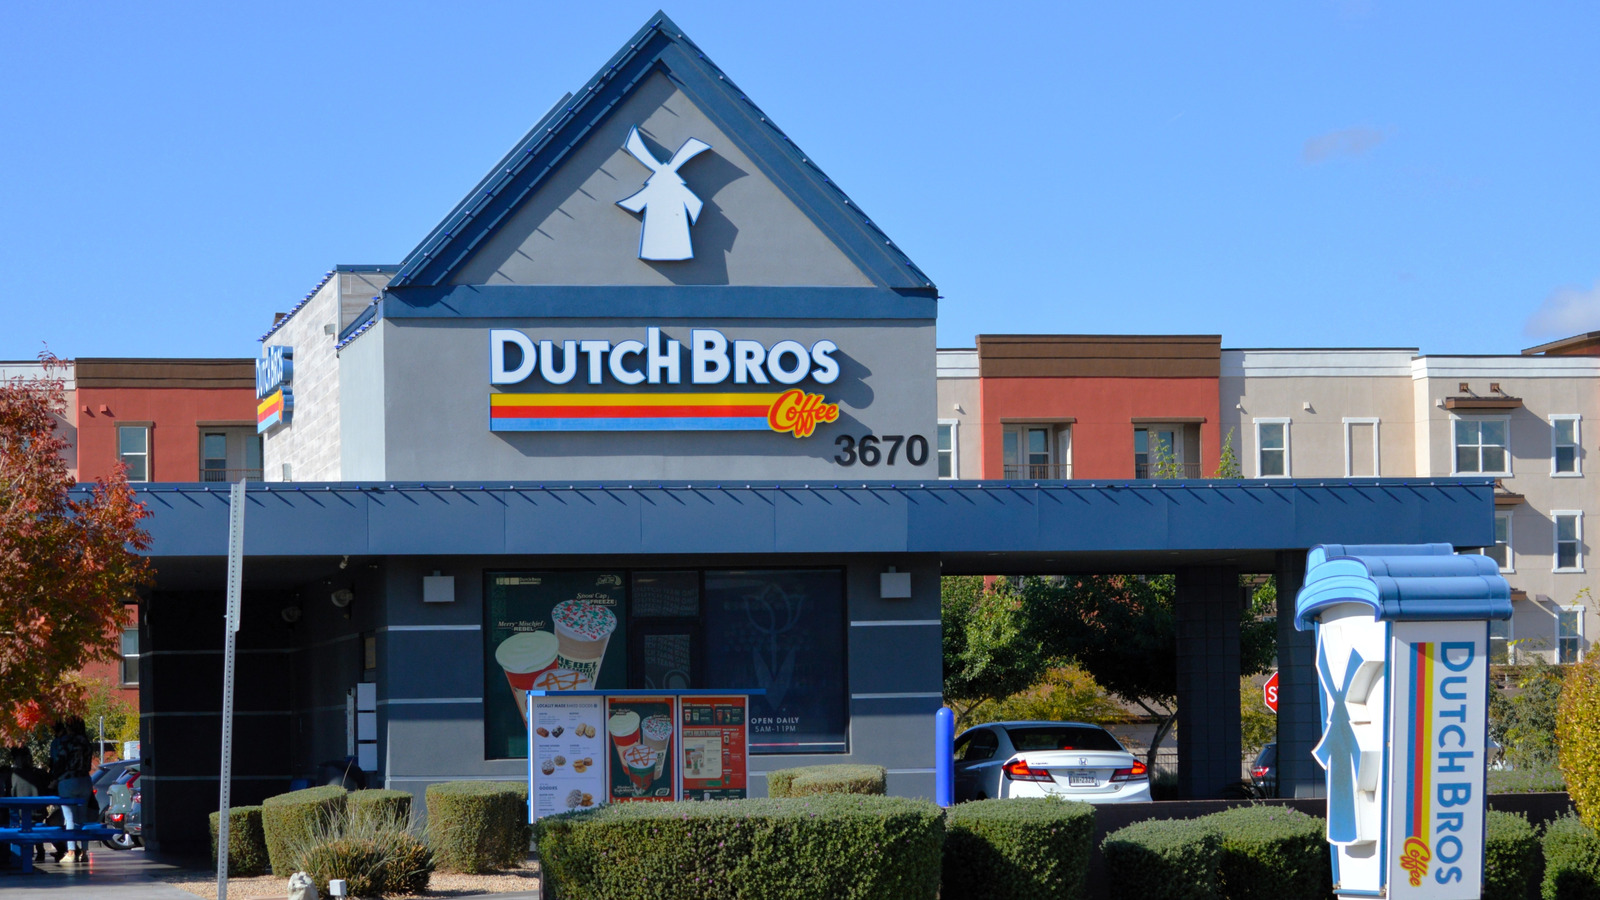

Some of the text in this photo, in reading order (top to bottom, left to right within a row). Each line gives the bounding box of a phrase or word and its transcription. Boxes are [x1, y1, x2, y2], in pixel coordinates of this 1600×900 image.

[489, 326, 840, 385] DUTCH BROS
[767, 389, 840, 438] Coffee
[833, 434, 929, 467] 3670
[594, 592, 607, 600] Cap
[557, 654, 597, 668] REBEL
[751, 716, 800, 725] OPEN DAILY
[755, 725, 796, 733] 5AM-11PM
[1434, 641, 1475, 885] DUTCH BROS
[1400, 837, 1432, 888] Coffee
